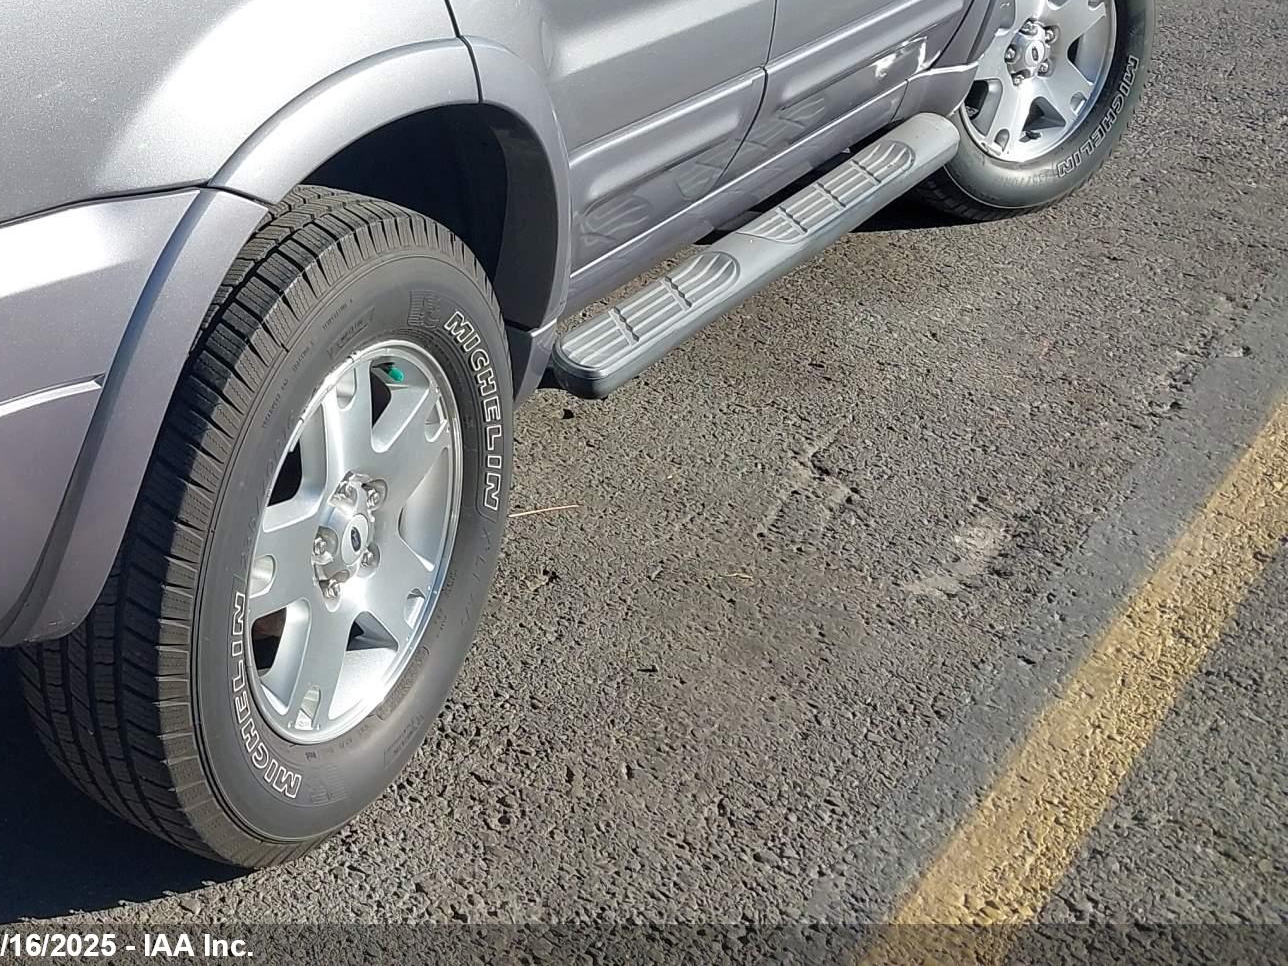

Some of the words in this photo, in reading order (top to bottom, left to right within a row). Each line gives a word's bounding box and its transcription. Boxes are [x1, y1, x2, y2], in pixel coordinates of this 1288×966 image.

[1056, 54, 1140, 178] MICHELIN
[443, 310, 503, 512] MICHELIN
[231, 591, 303, 800] MICHELIN
